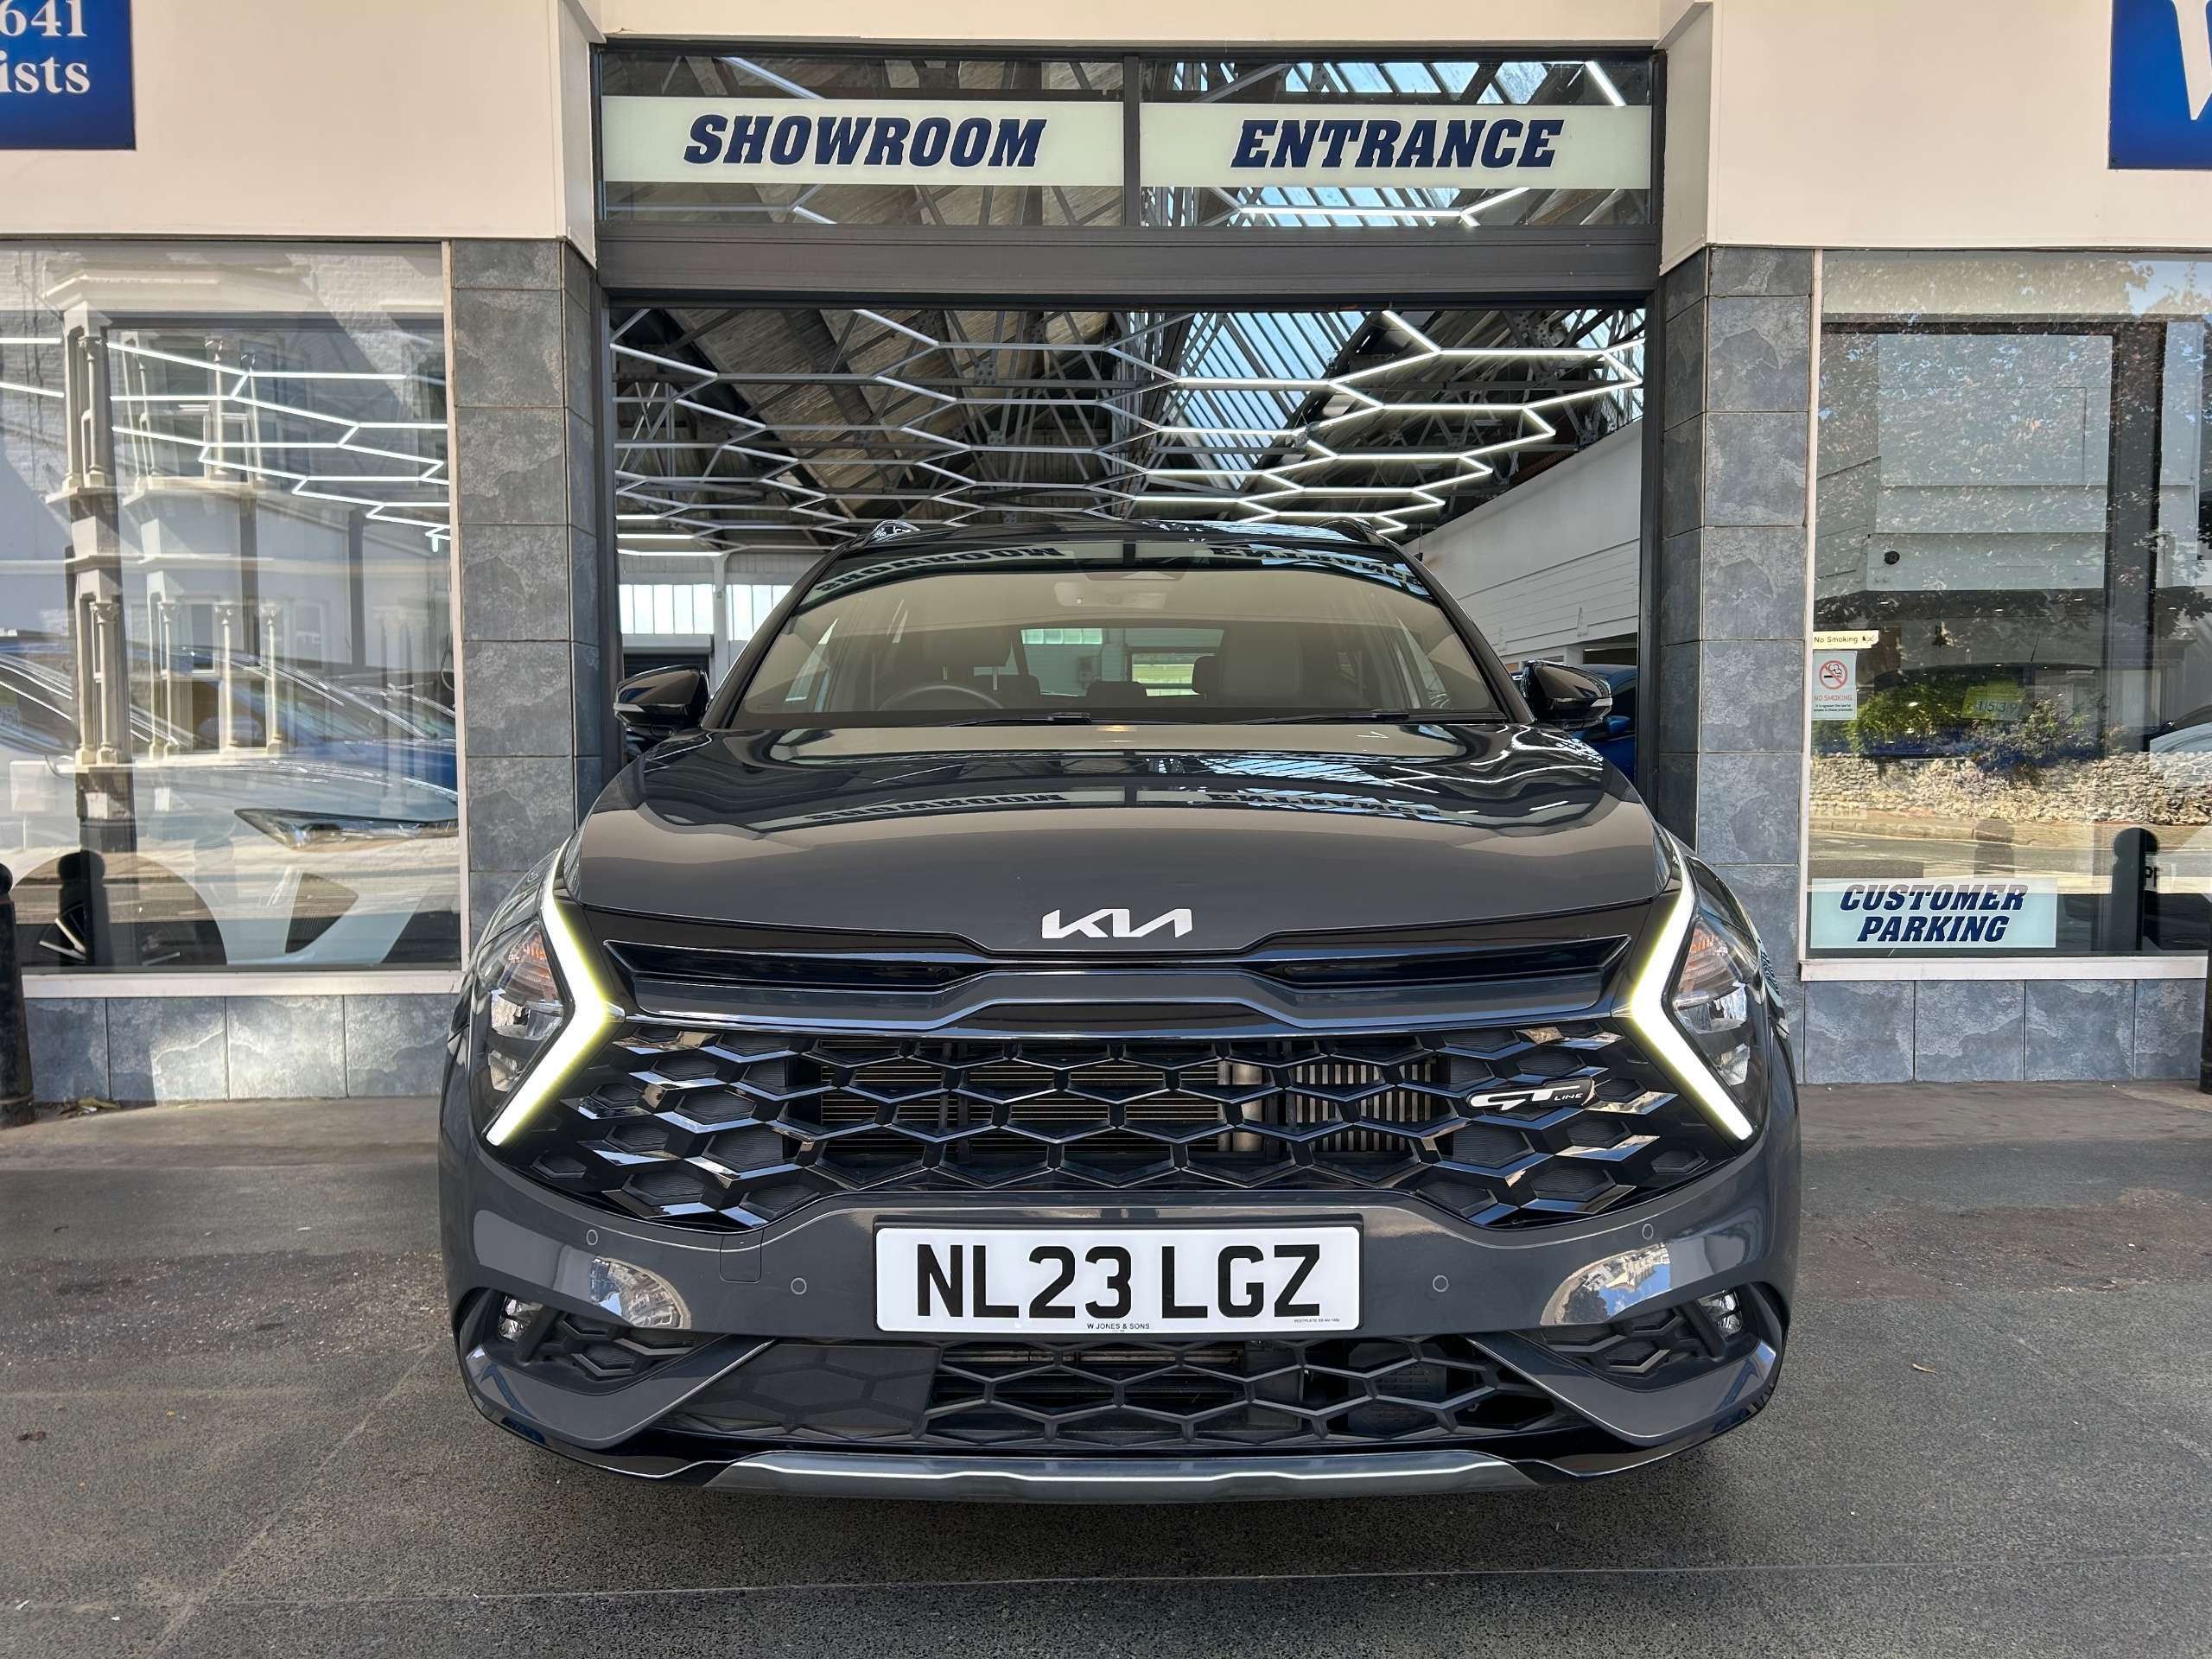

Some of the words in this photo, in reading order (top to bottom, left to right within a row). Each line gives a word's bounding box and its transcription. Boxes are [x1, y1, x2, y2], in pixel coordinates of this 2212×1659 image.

[0, 0, 87, 37] 641
[683, 114, 1047, 168] SHOWROOM
[1230, 119, 1565, 168] ENTRANCE
[1827, 636, 1859, 645] Smoking
[1840, 884, 2029, 911] CUSTOMER
[1042, 909, 1192, 938] KIA
[1857, 916, 2011, 942] PARKING
[1470, 1085, 1580, 1111] GT
[1554, 1092, 1584, 1101] LINE
[917, 1243, 1132, 1319] NL23
[1161, 1244, 1321, 1319] LGZ
